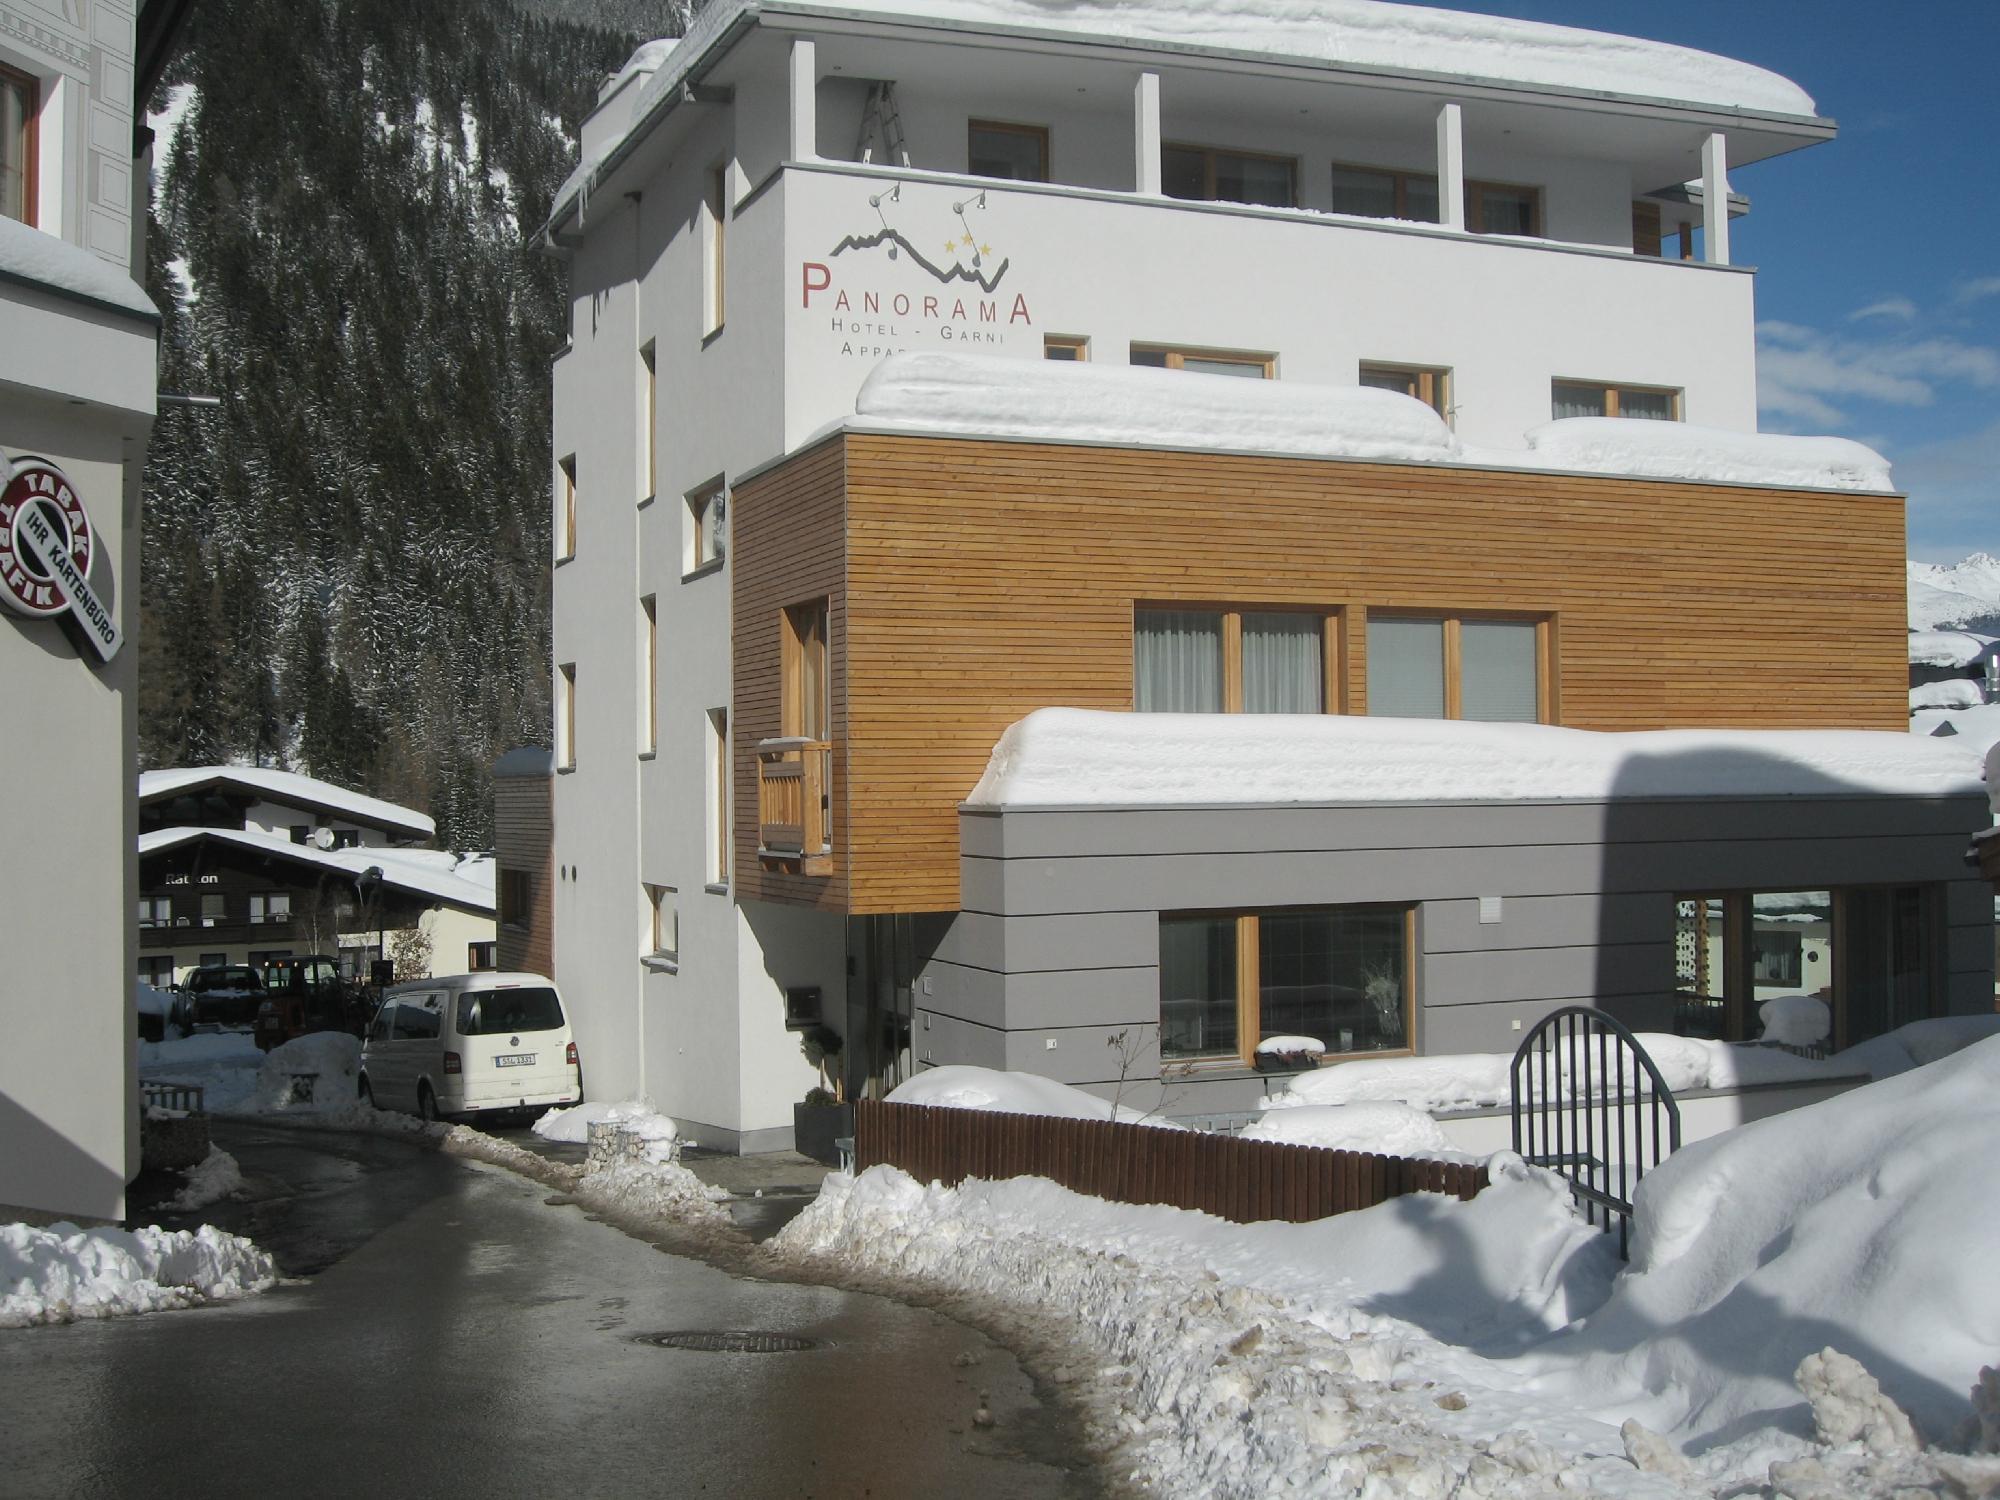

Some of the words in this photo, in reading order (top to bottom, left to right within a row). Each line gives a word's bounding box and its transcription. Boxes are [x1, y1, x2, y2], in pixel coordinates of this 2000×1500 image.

[803, 262, 1031, 325] PANORAMA
[832, 317, 898, 336] HOTEL
[940, 326, 1004, 344] GARNI
[0, 503, 54, 606] TRAFIK
[24, 474, 88, 556] TABAK
[25, 511, 49, 546] IHR
[48, 544, 116, 645] KARTENBÜRO
